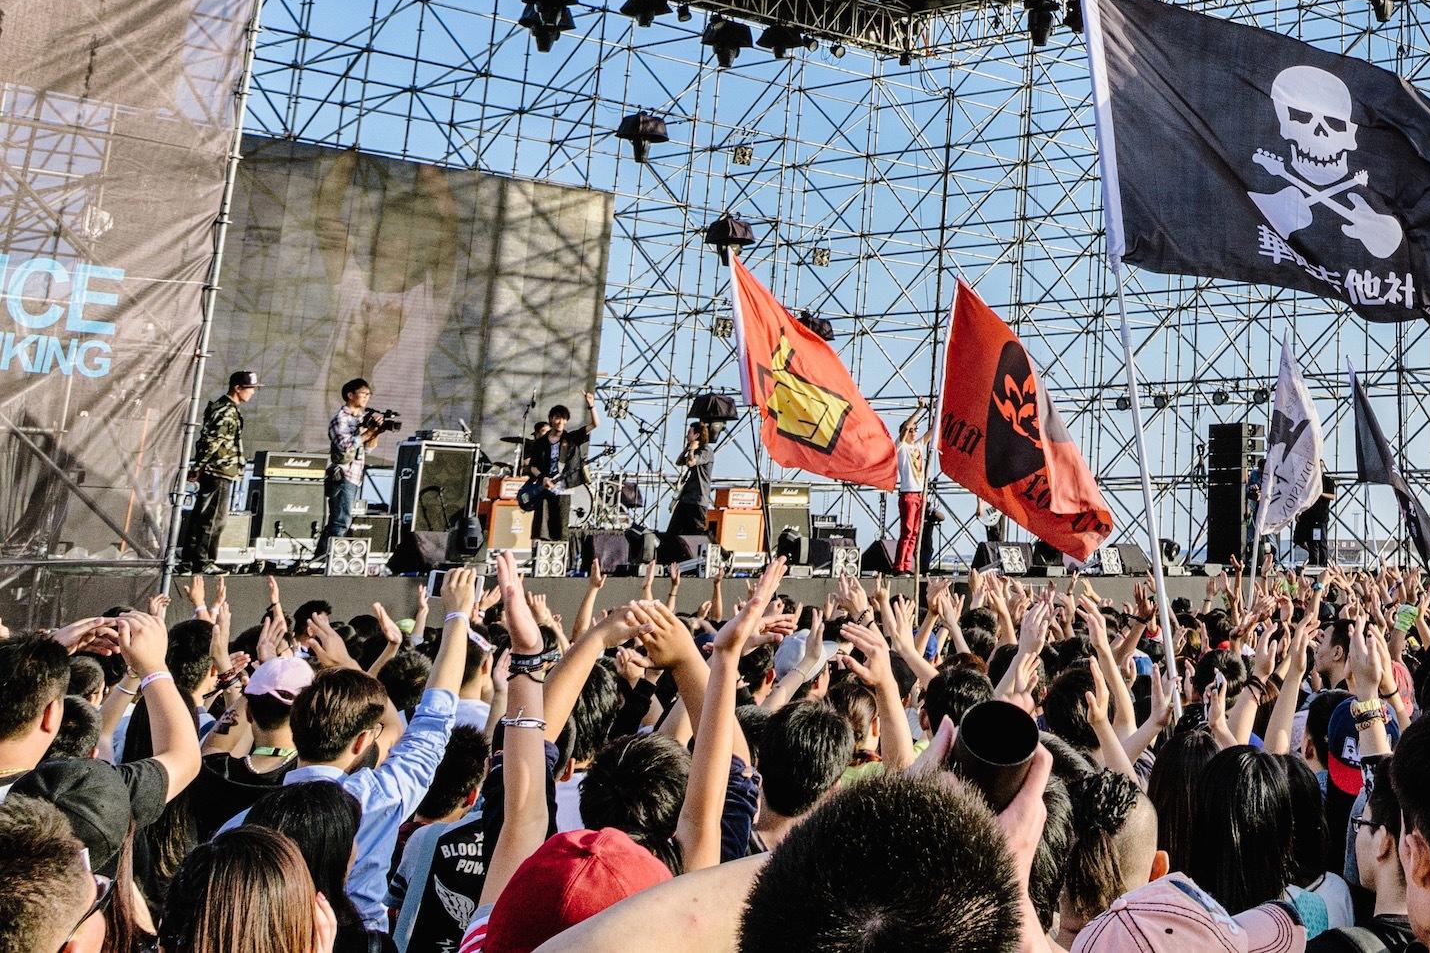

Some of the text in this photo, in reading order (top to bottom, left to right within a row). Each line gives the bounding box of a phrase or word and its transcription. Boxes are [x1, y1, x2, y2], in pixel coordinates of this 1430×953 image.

[0, 253, 125, 335] CE
[0, 330, 112, 378] KING
[456, 858, 486, 876] POW
